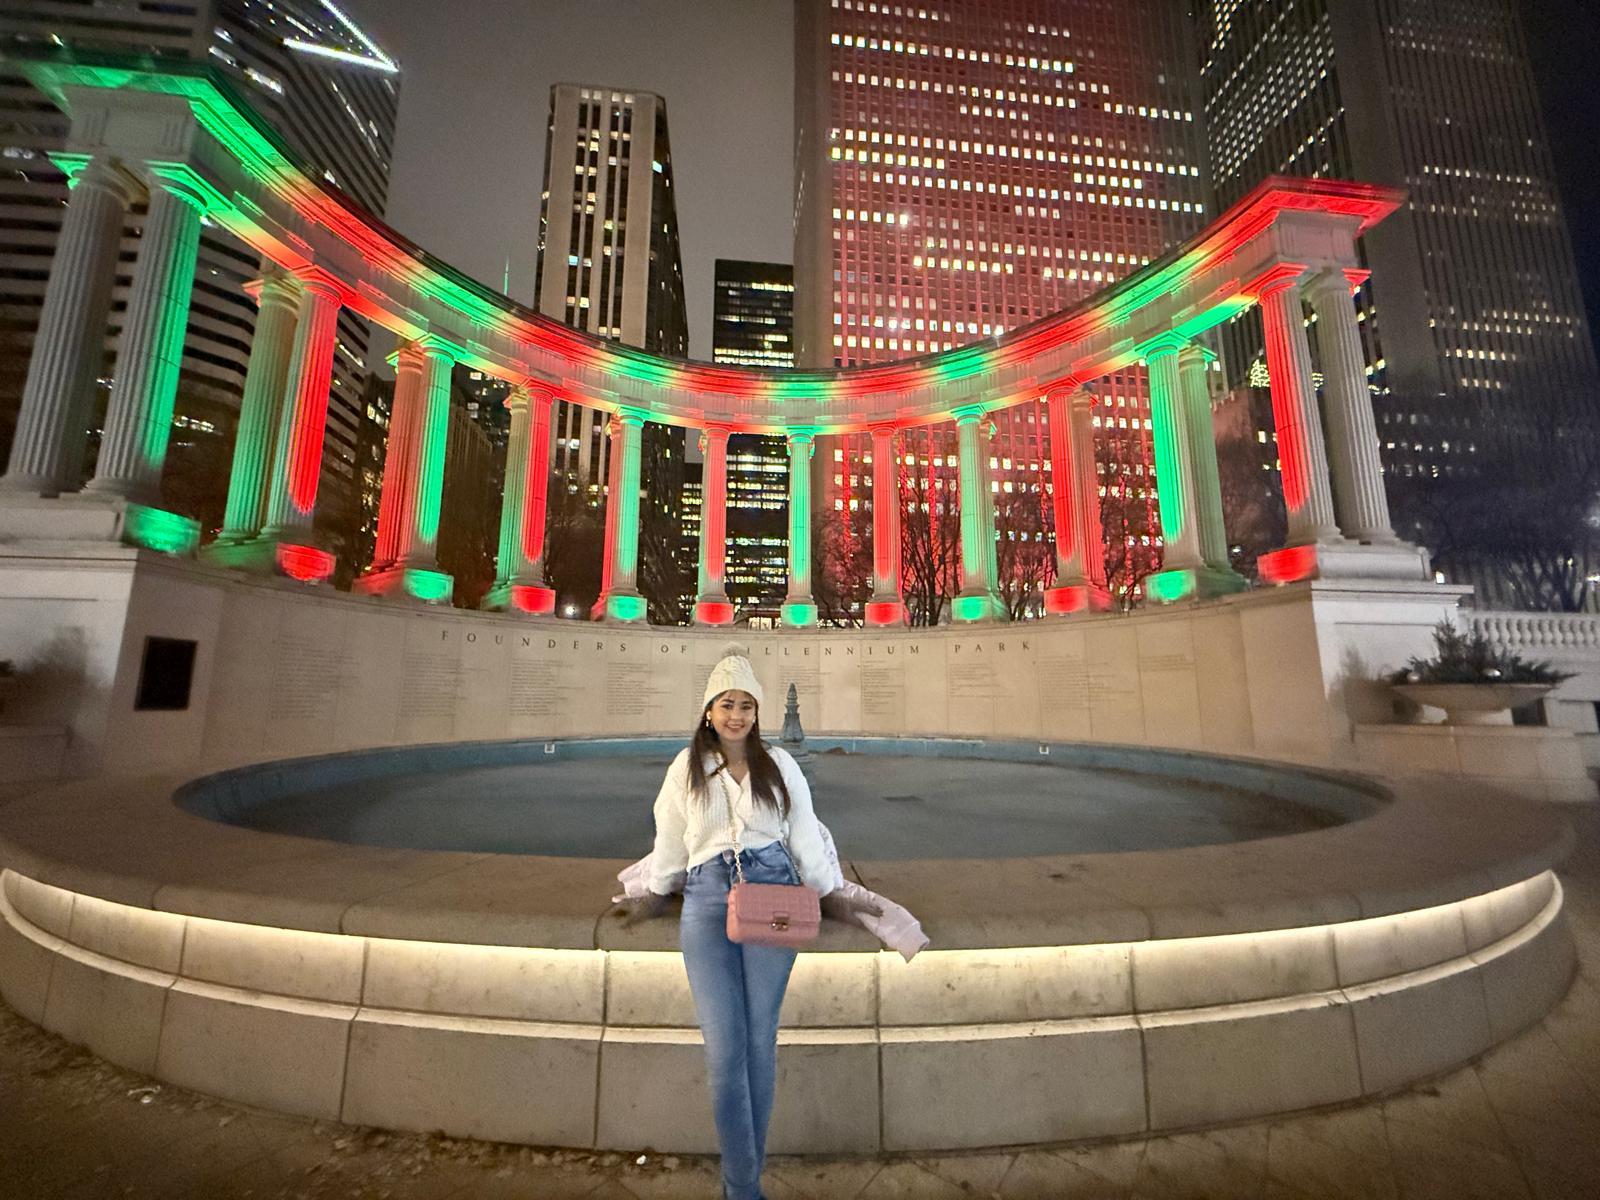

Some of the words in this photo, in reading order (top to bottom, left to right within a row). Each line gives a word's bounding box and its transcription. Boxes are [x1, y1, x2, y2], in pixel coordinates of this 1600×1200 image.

[441, 630, 627, 652] FOUNDERS
[660, 644, 688, 654] OF
[746, 644, 920, 656] ILLENNIUM
[954, 641, 1030, 653] PARK
